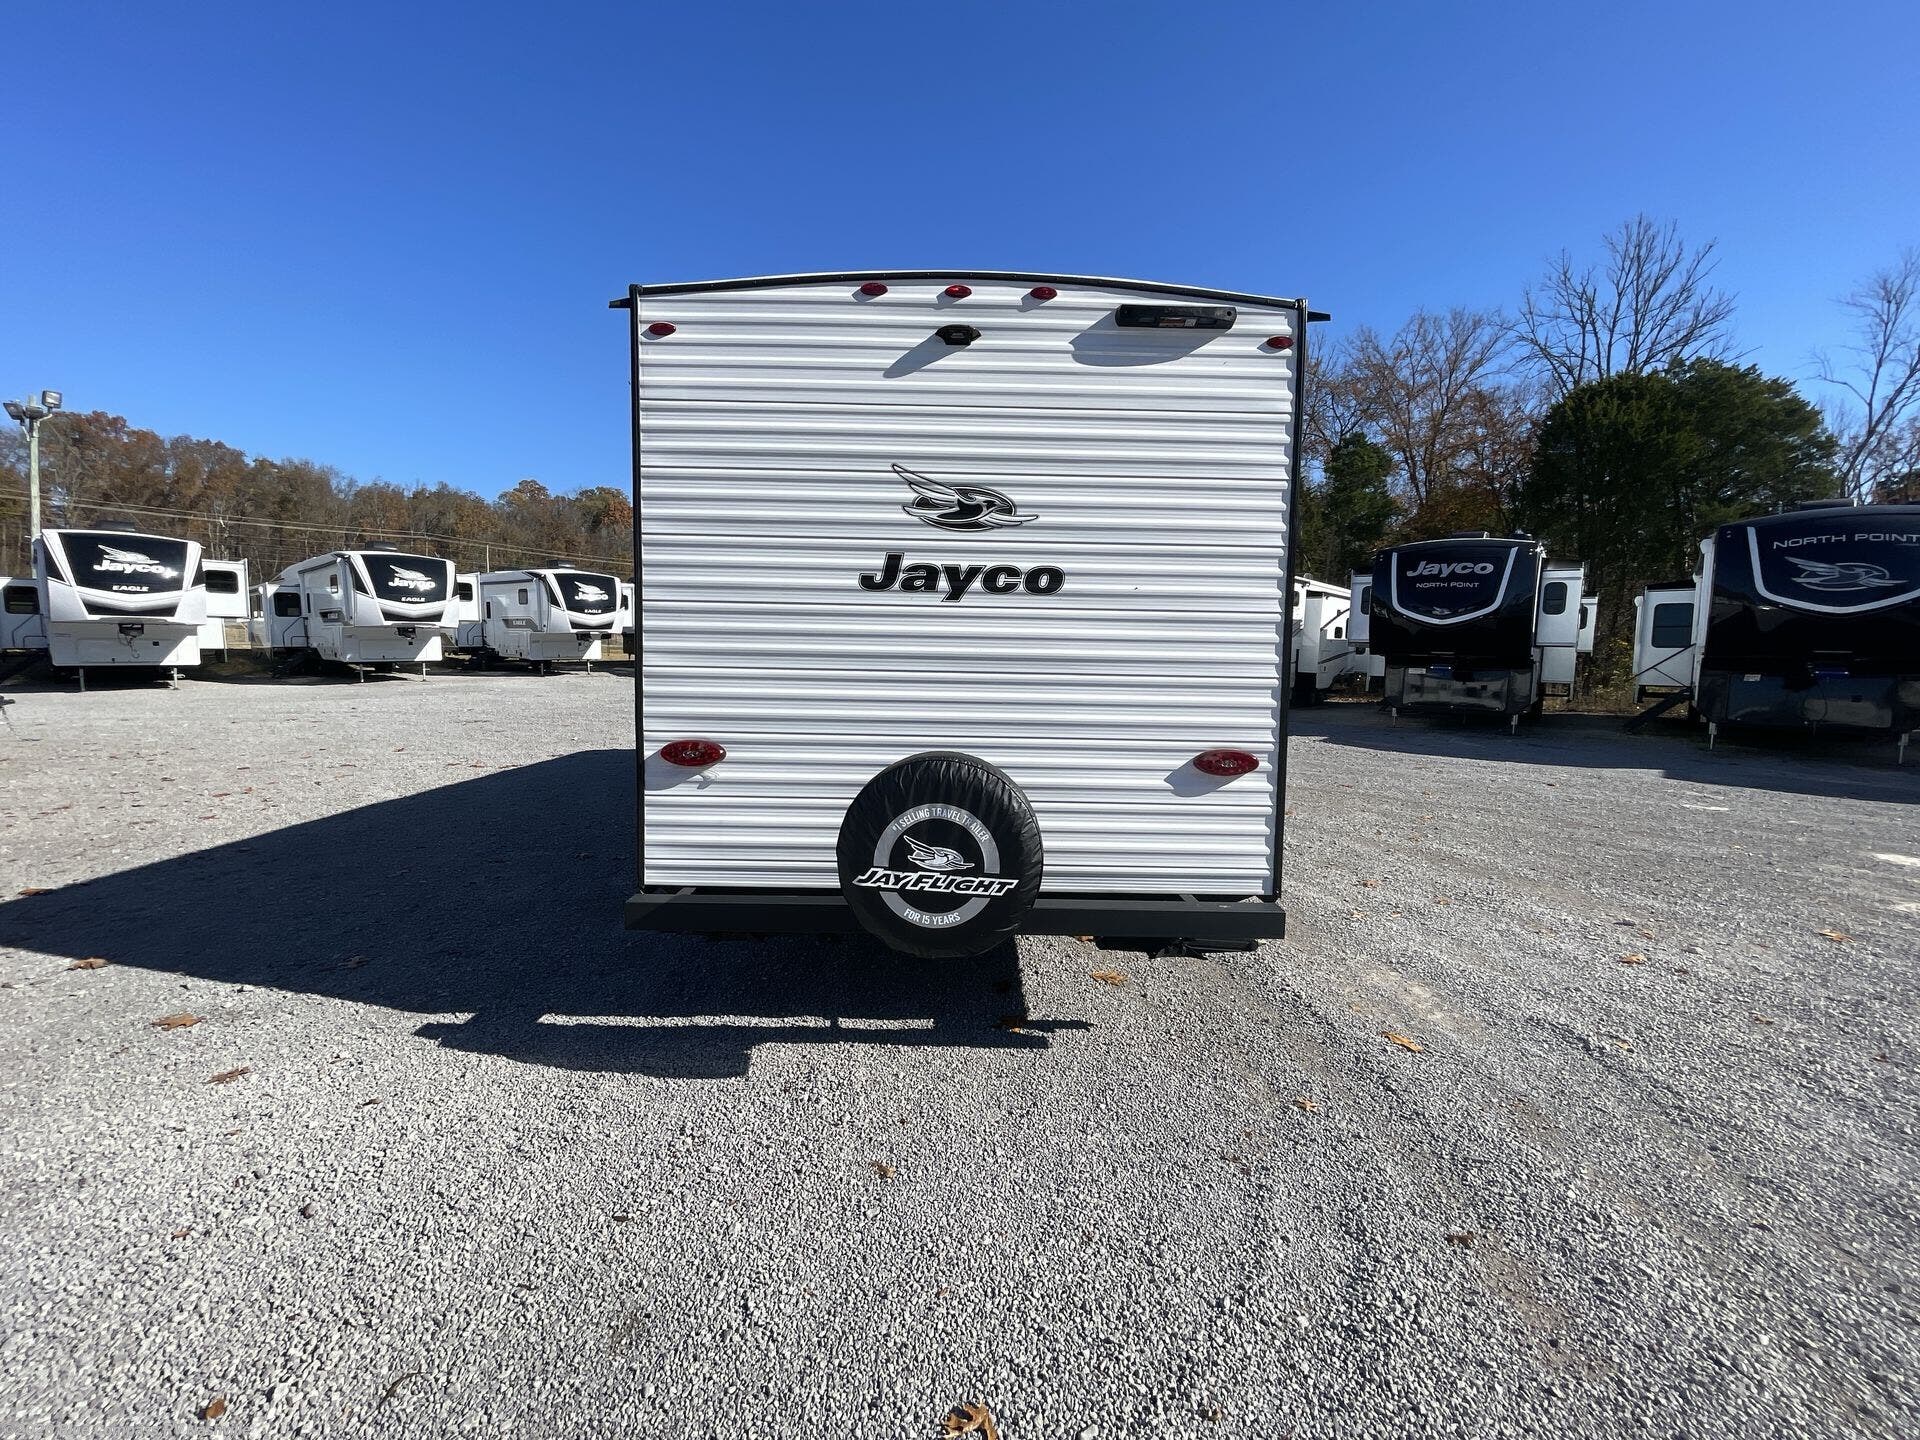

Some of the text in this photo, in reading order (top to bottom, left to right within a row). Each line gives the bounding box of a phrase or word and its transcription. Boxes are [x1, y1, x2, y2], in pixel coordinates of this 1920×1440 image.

[1773, 533, 1920, 549] NORTH POINT
[93, 559, 166, 574] Jayco
[1406, 561, 1494, 577] Jayco
[858, 552, 1066, 602] Jayco
[899, 808, 930, 827] SELLING
[932, 807, 961, 822] TRAVEL
[961, 814, 990, 843] TRAILER
[903, 908, 961, 925] FOR 15 YEARS
